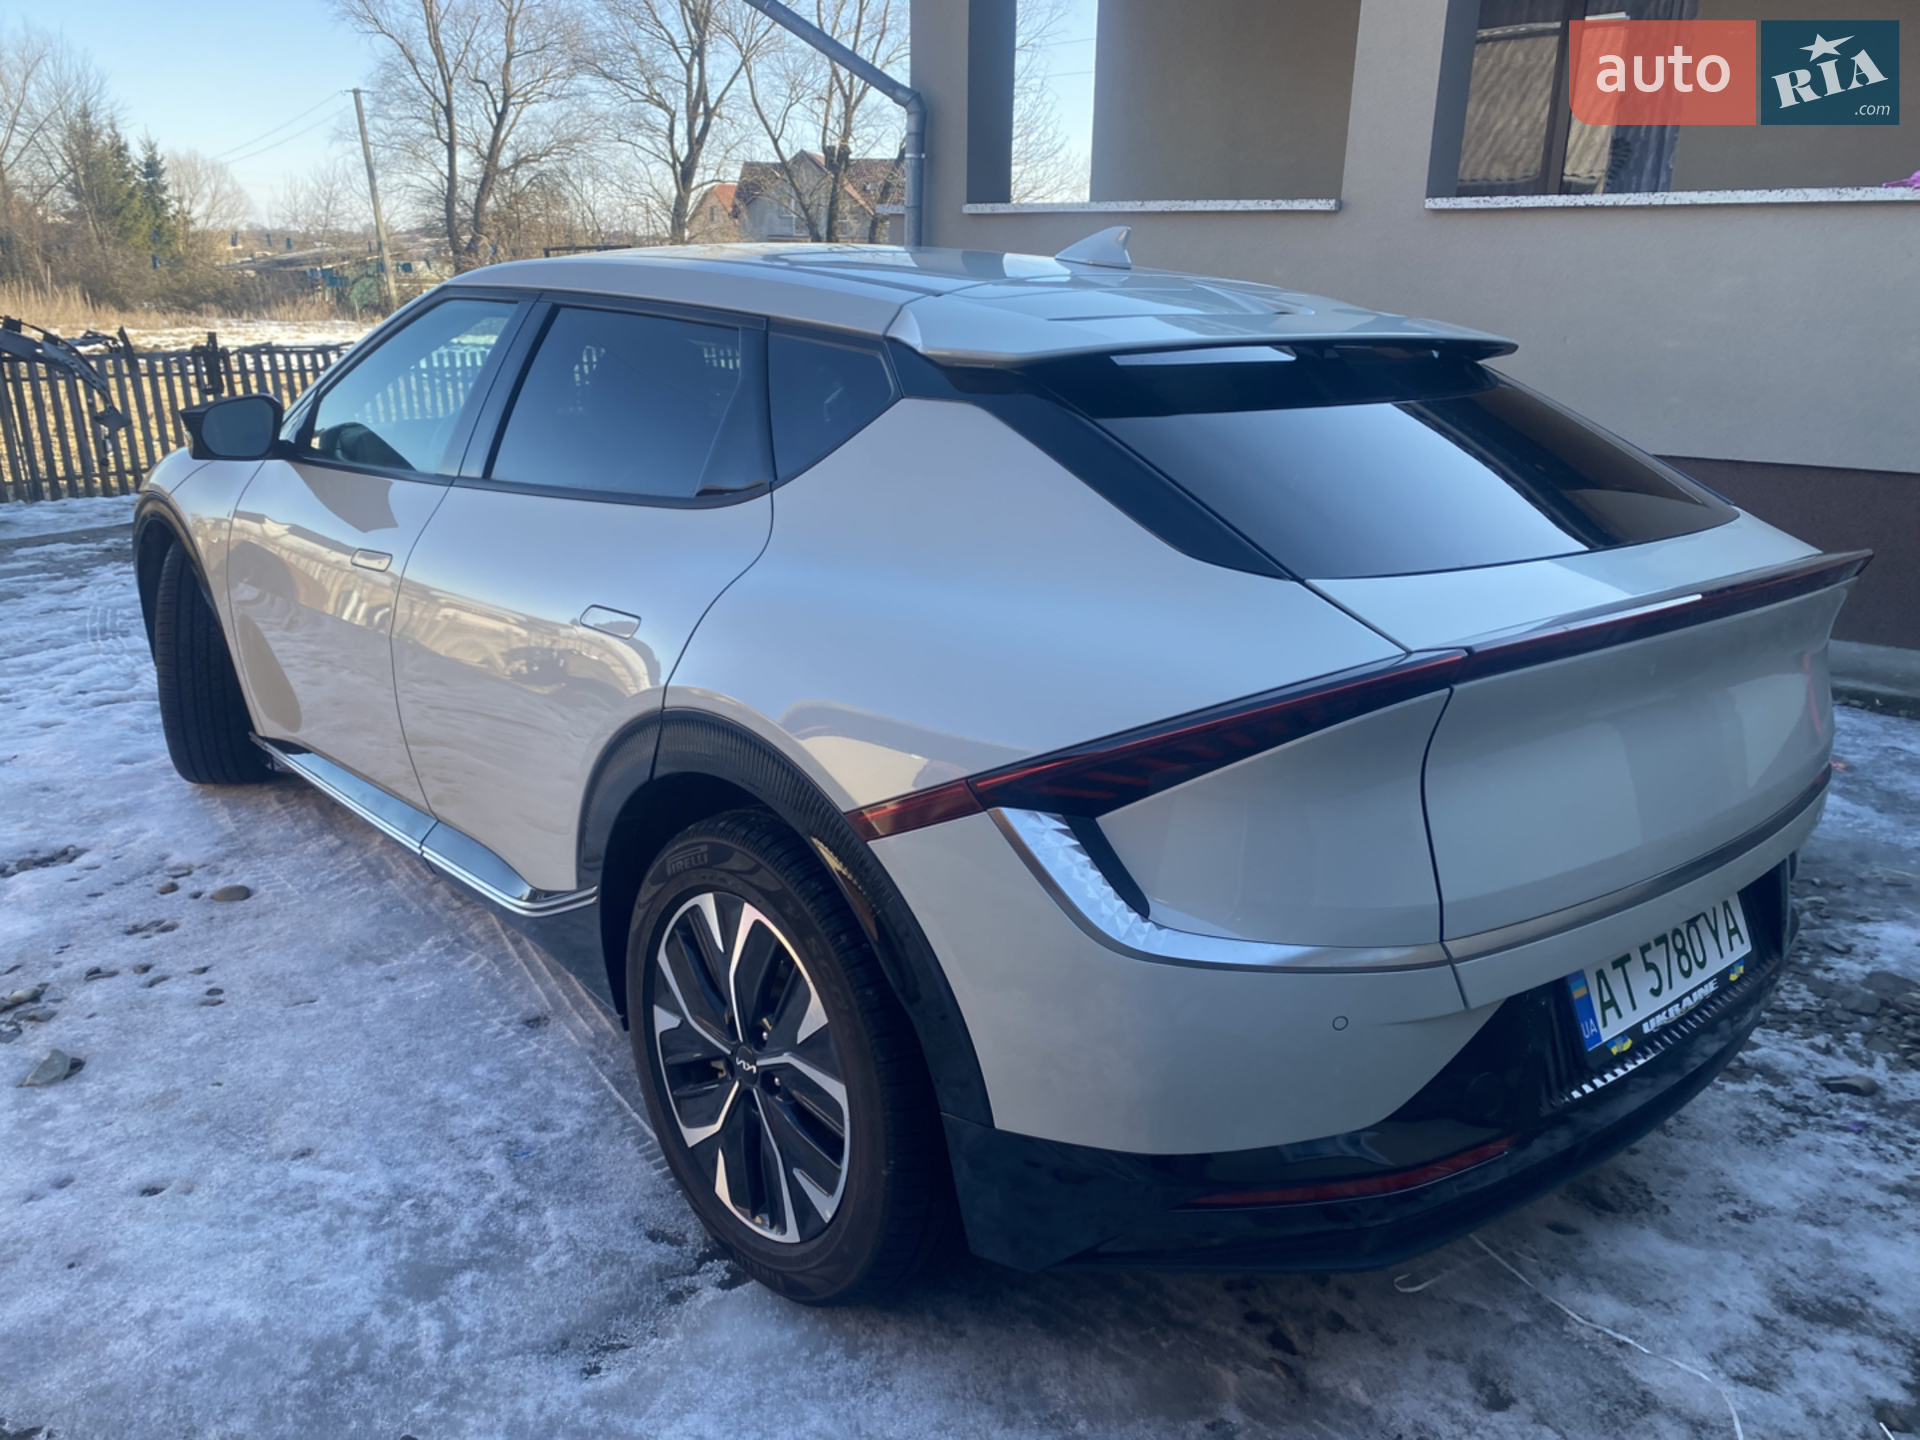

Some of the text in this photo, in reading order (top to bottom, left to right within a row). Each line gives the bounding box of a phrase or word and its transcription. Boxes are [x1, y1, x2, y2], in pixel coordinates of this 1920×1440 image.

[665, 844, 709, 877] PIRELLI
[1595, 899, 1745, 1028] AT 5780 YA
[1642, 978, 1719, 1034] UKRAINE
[1581, 1018, 1598, 1039] UA
